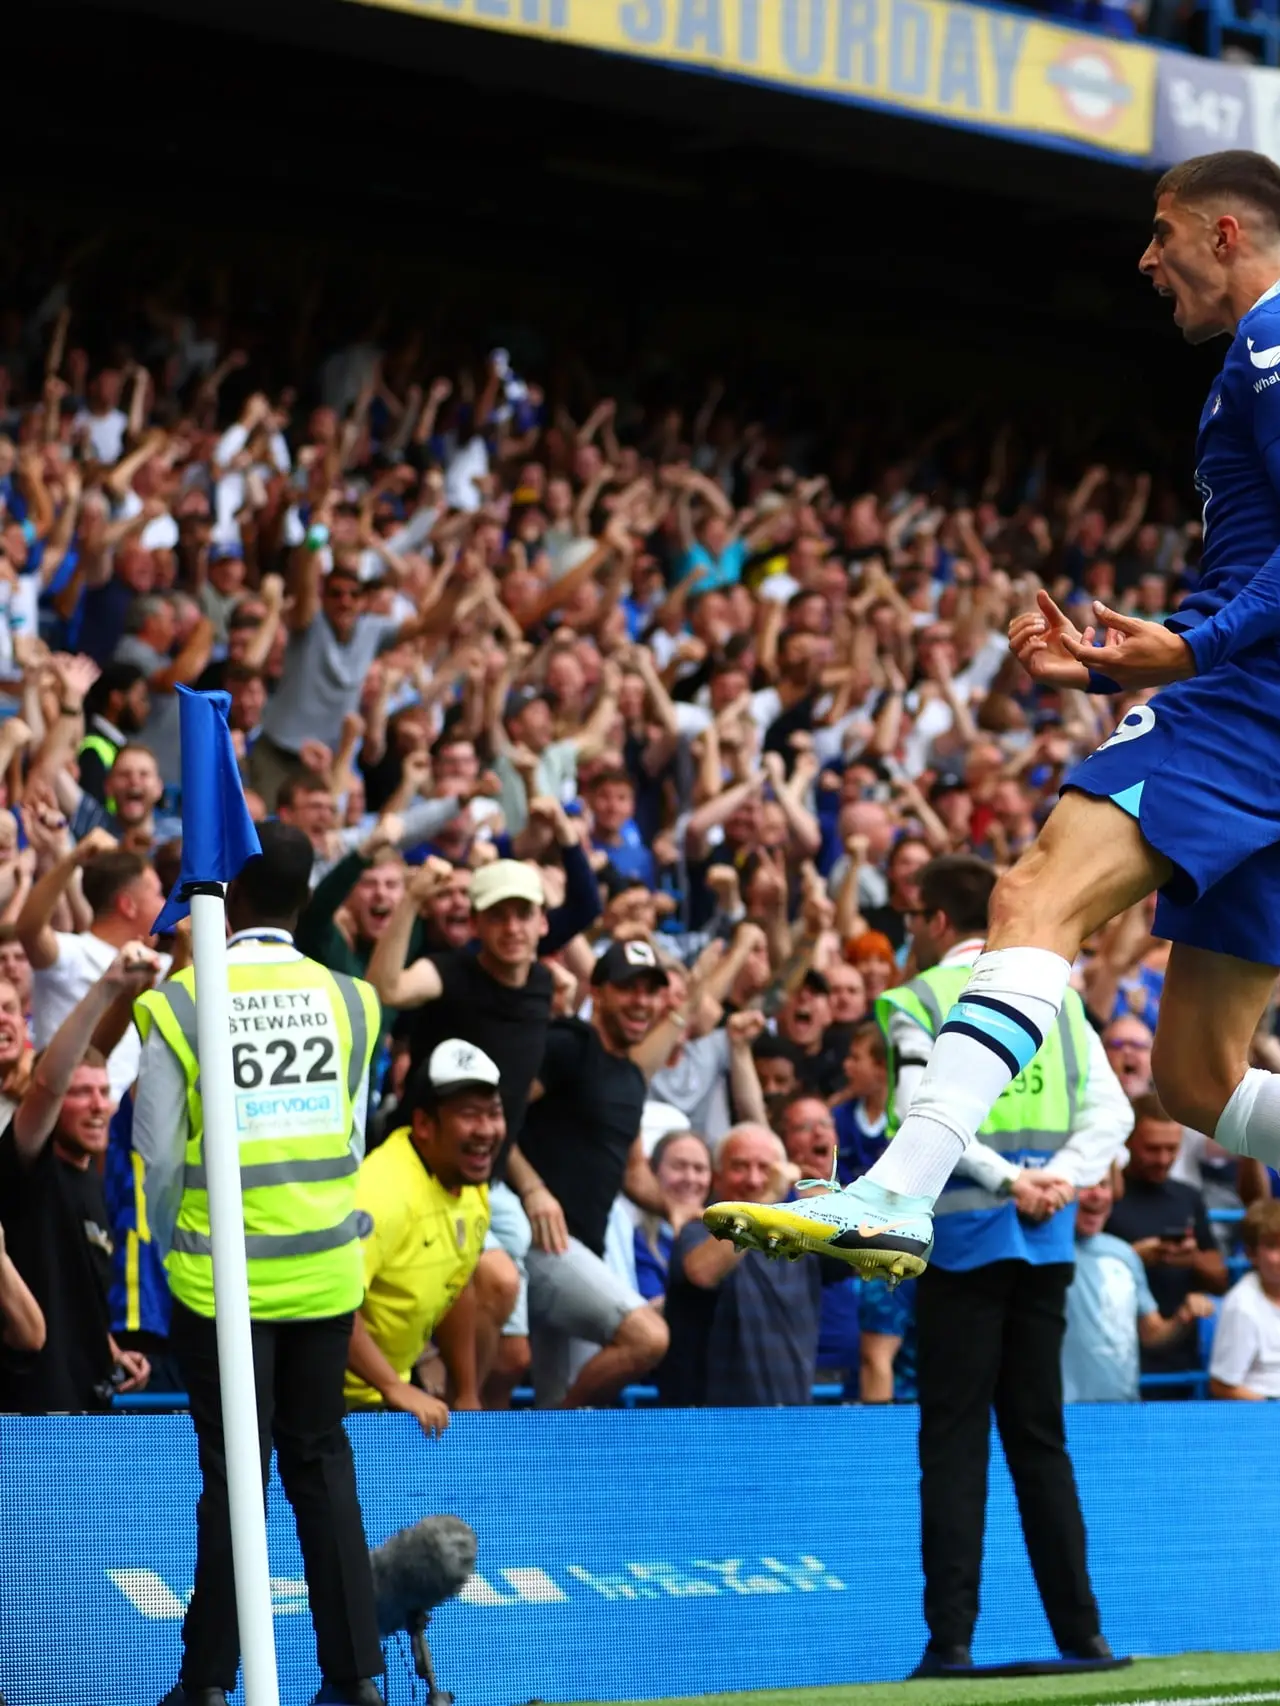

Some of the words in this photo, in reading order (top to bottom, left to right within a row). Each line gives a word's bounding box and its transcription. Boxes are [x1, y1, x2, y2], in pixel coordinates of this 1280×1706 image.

[619, 0, 1030, 113] SATURDAY
[232, 993, 311, 1012] SAFETY
[229, 1012, 328, 1035] STEWARD
[232, 1036, 338, 1089] 622
[245, 1095, 331, 1118] servoca
